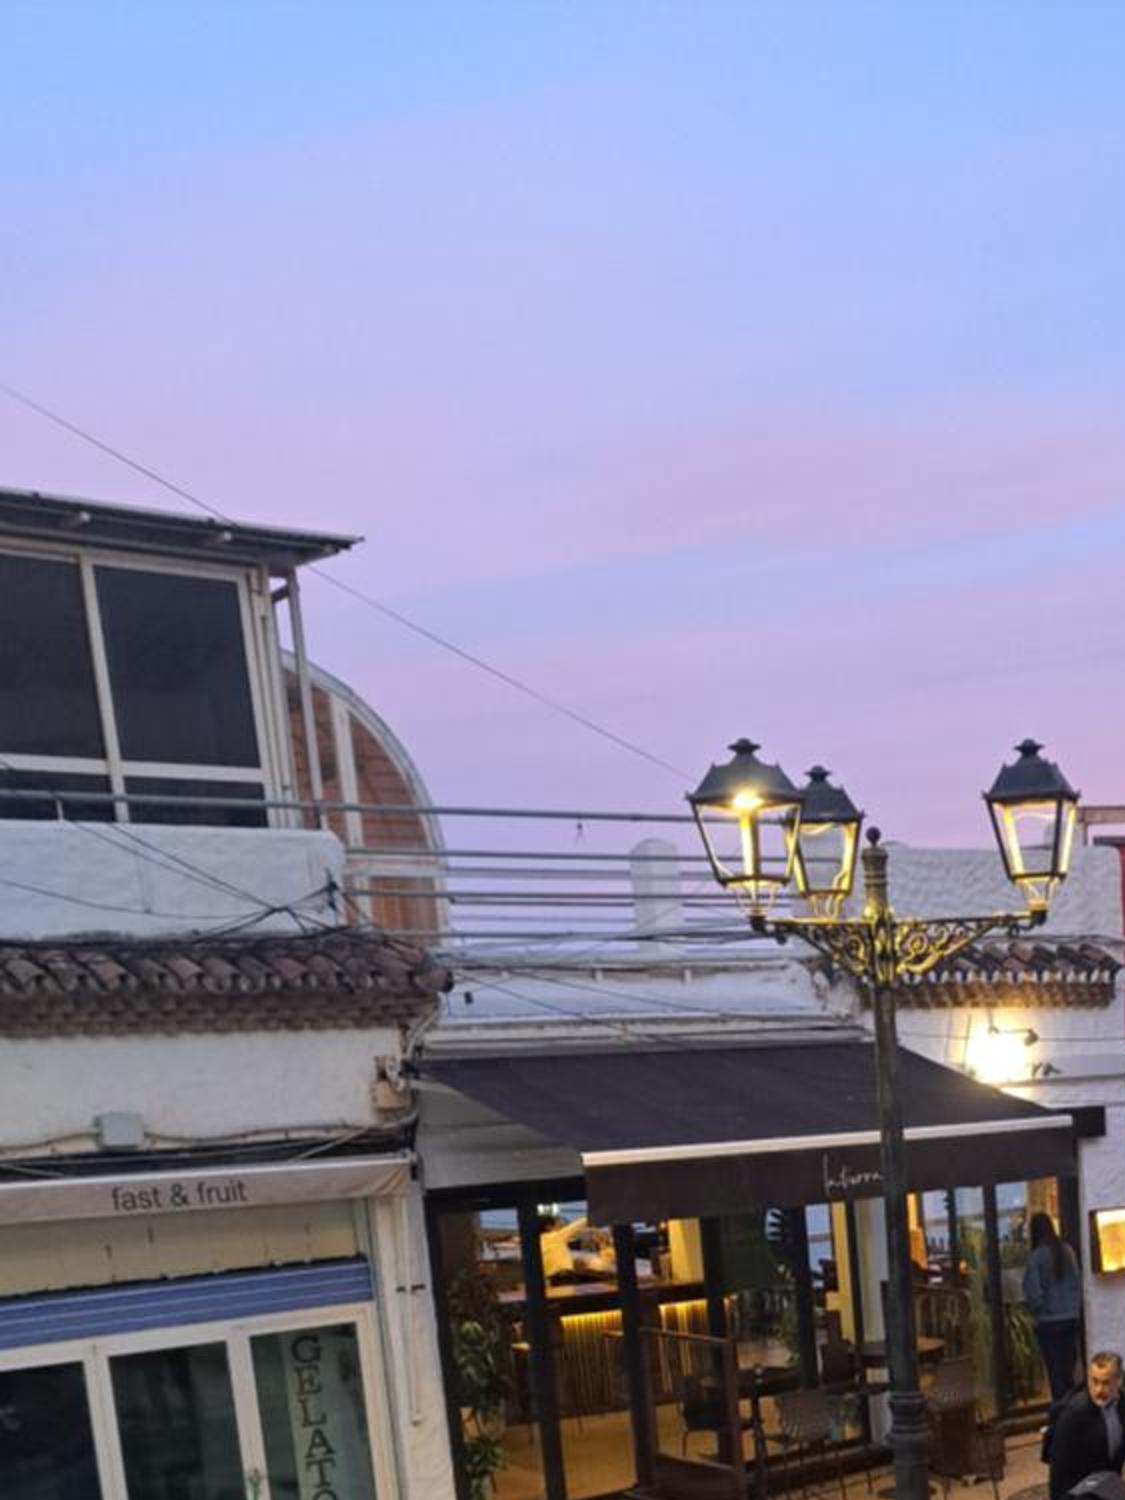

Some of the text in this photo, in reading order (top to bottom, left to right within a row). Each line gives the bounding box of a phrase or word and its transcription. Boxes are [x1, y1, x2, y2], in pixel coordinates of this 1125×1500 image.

[111, 1178, 248, 1211] fast & fruit
